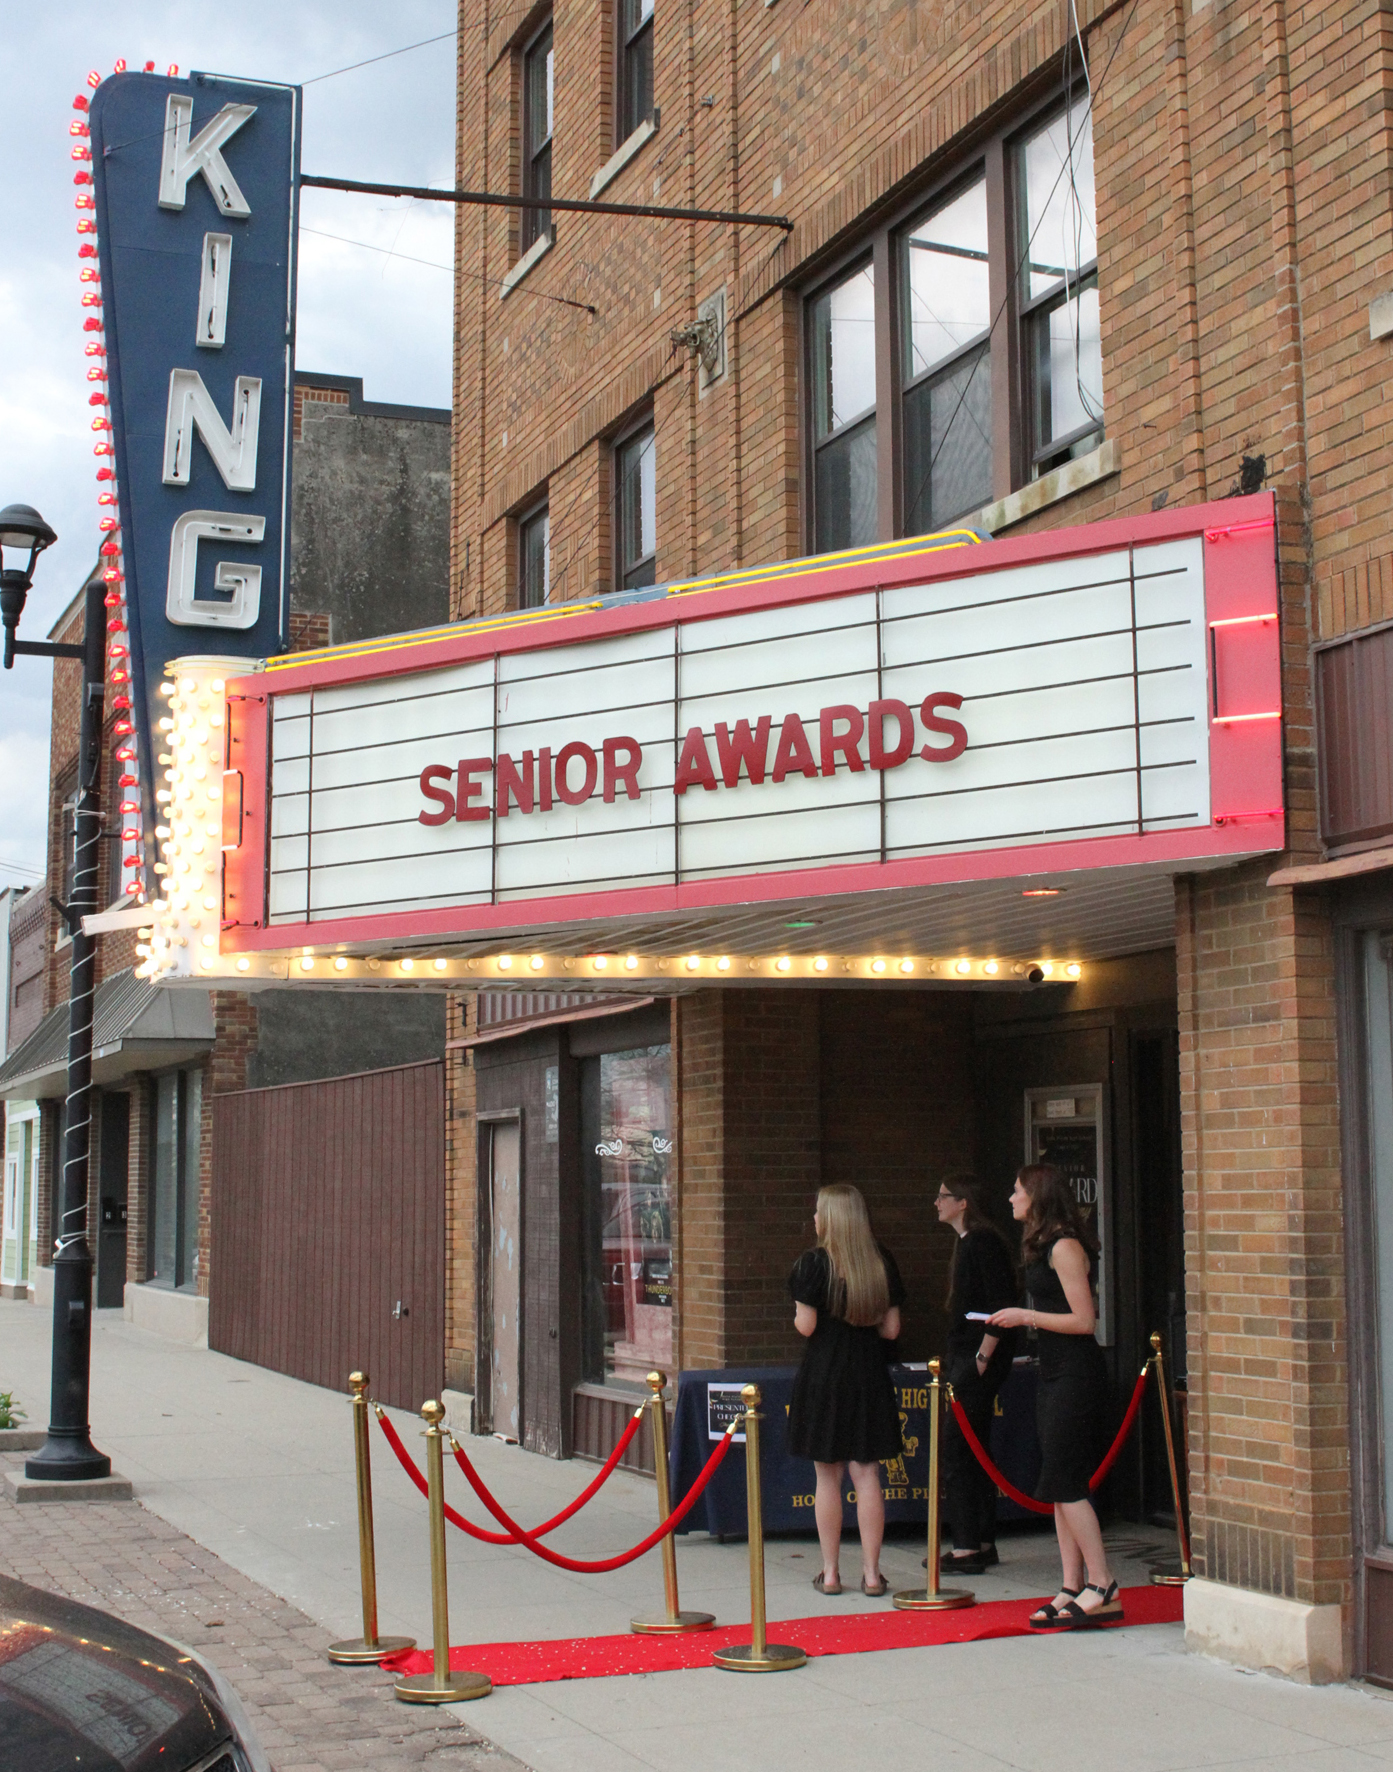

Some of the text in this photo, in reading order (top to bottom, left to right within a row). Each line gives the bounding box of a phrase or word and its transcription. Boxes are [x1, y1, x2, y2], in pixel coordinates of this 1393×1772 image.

[158, 94, 266, 629] KING
[418, 691, 968, 827] SENIOR AWARDS
